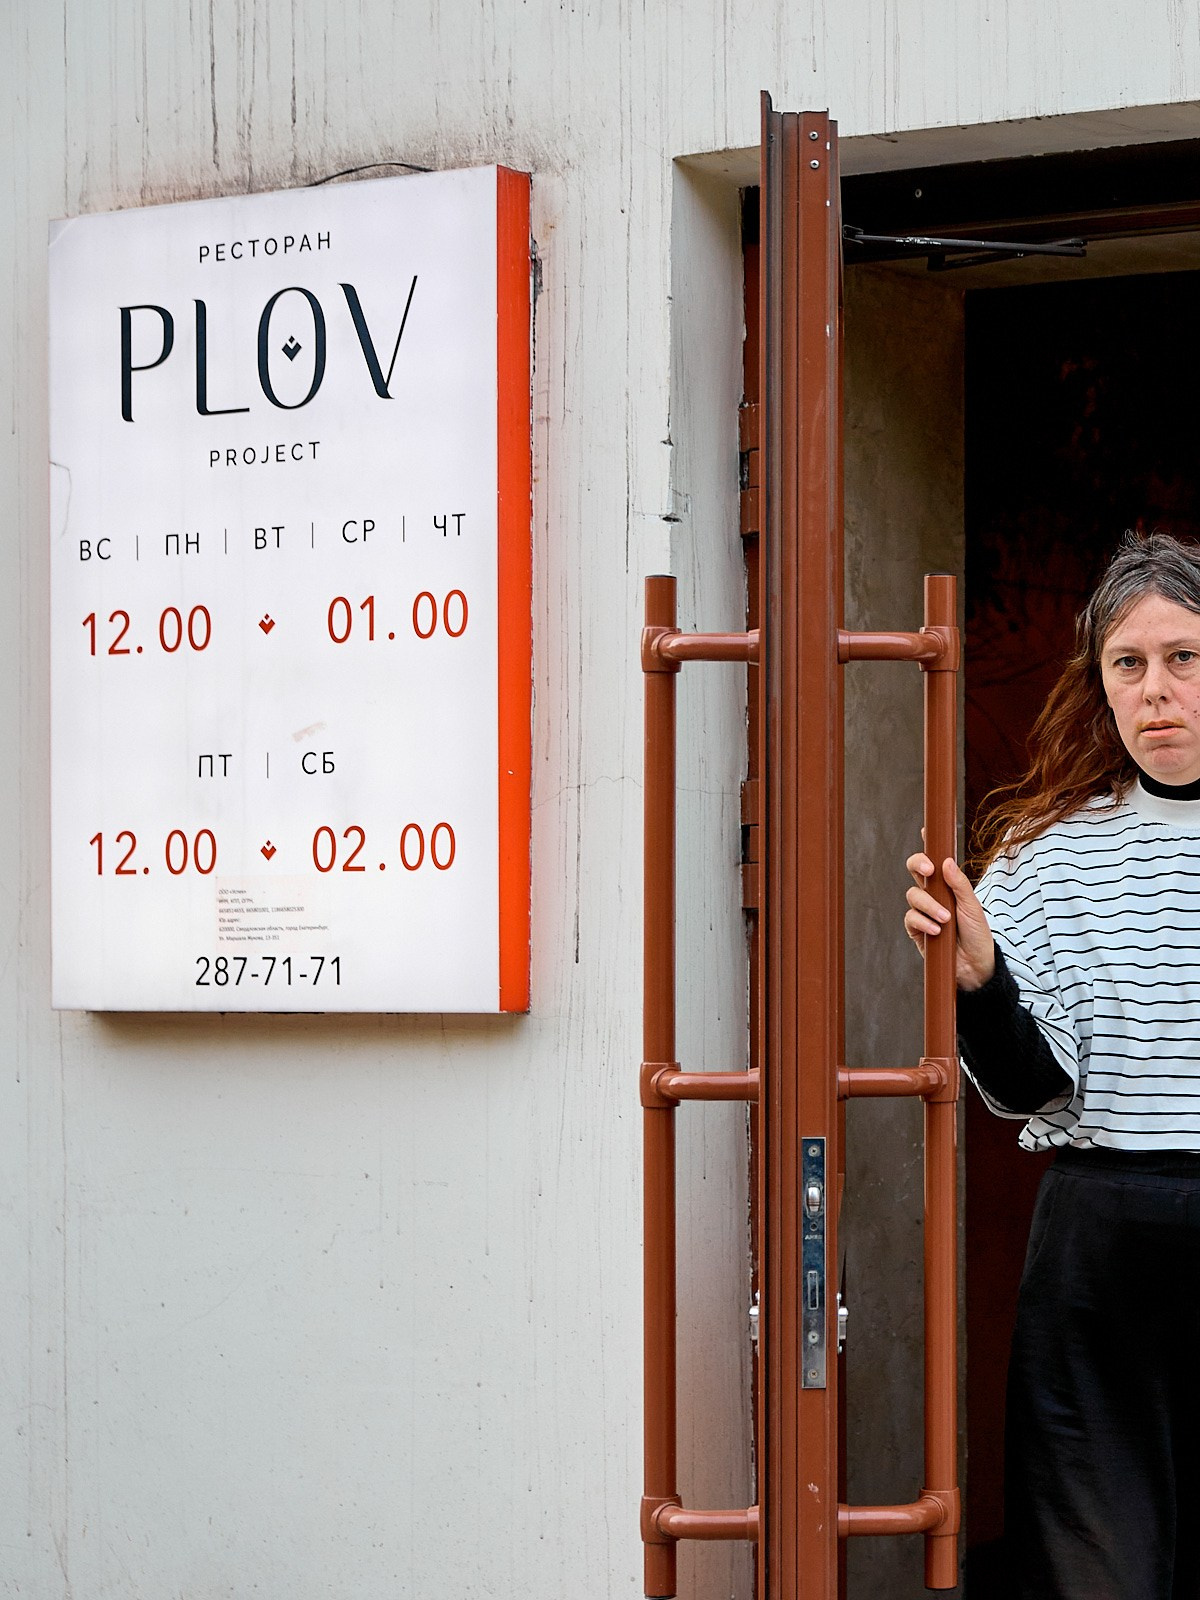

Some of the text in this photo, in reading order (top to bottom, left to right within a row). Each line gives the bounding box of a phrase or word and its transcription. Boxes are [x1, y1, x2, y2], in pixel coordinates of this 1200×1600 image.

[199, 231, 331, 264] РЕСТОРАН
[119, 275, 418, 423] PLOV
[209, 441, 321, 468] PROJECT
[79, 513, 466, 562] ВС ПН ВТ СР ЧТ
[82, 589, 469, 656] 12.00 01.00
[198, 751, 335, 778] ПТ СБ
[89, 822, 456, 876] 12.00 02.00
[194, 955, 342, 987] 287-71-71
